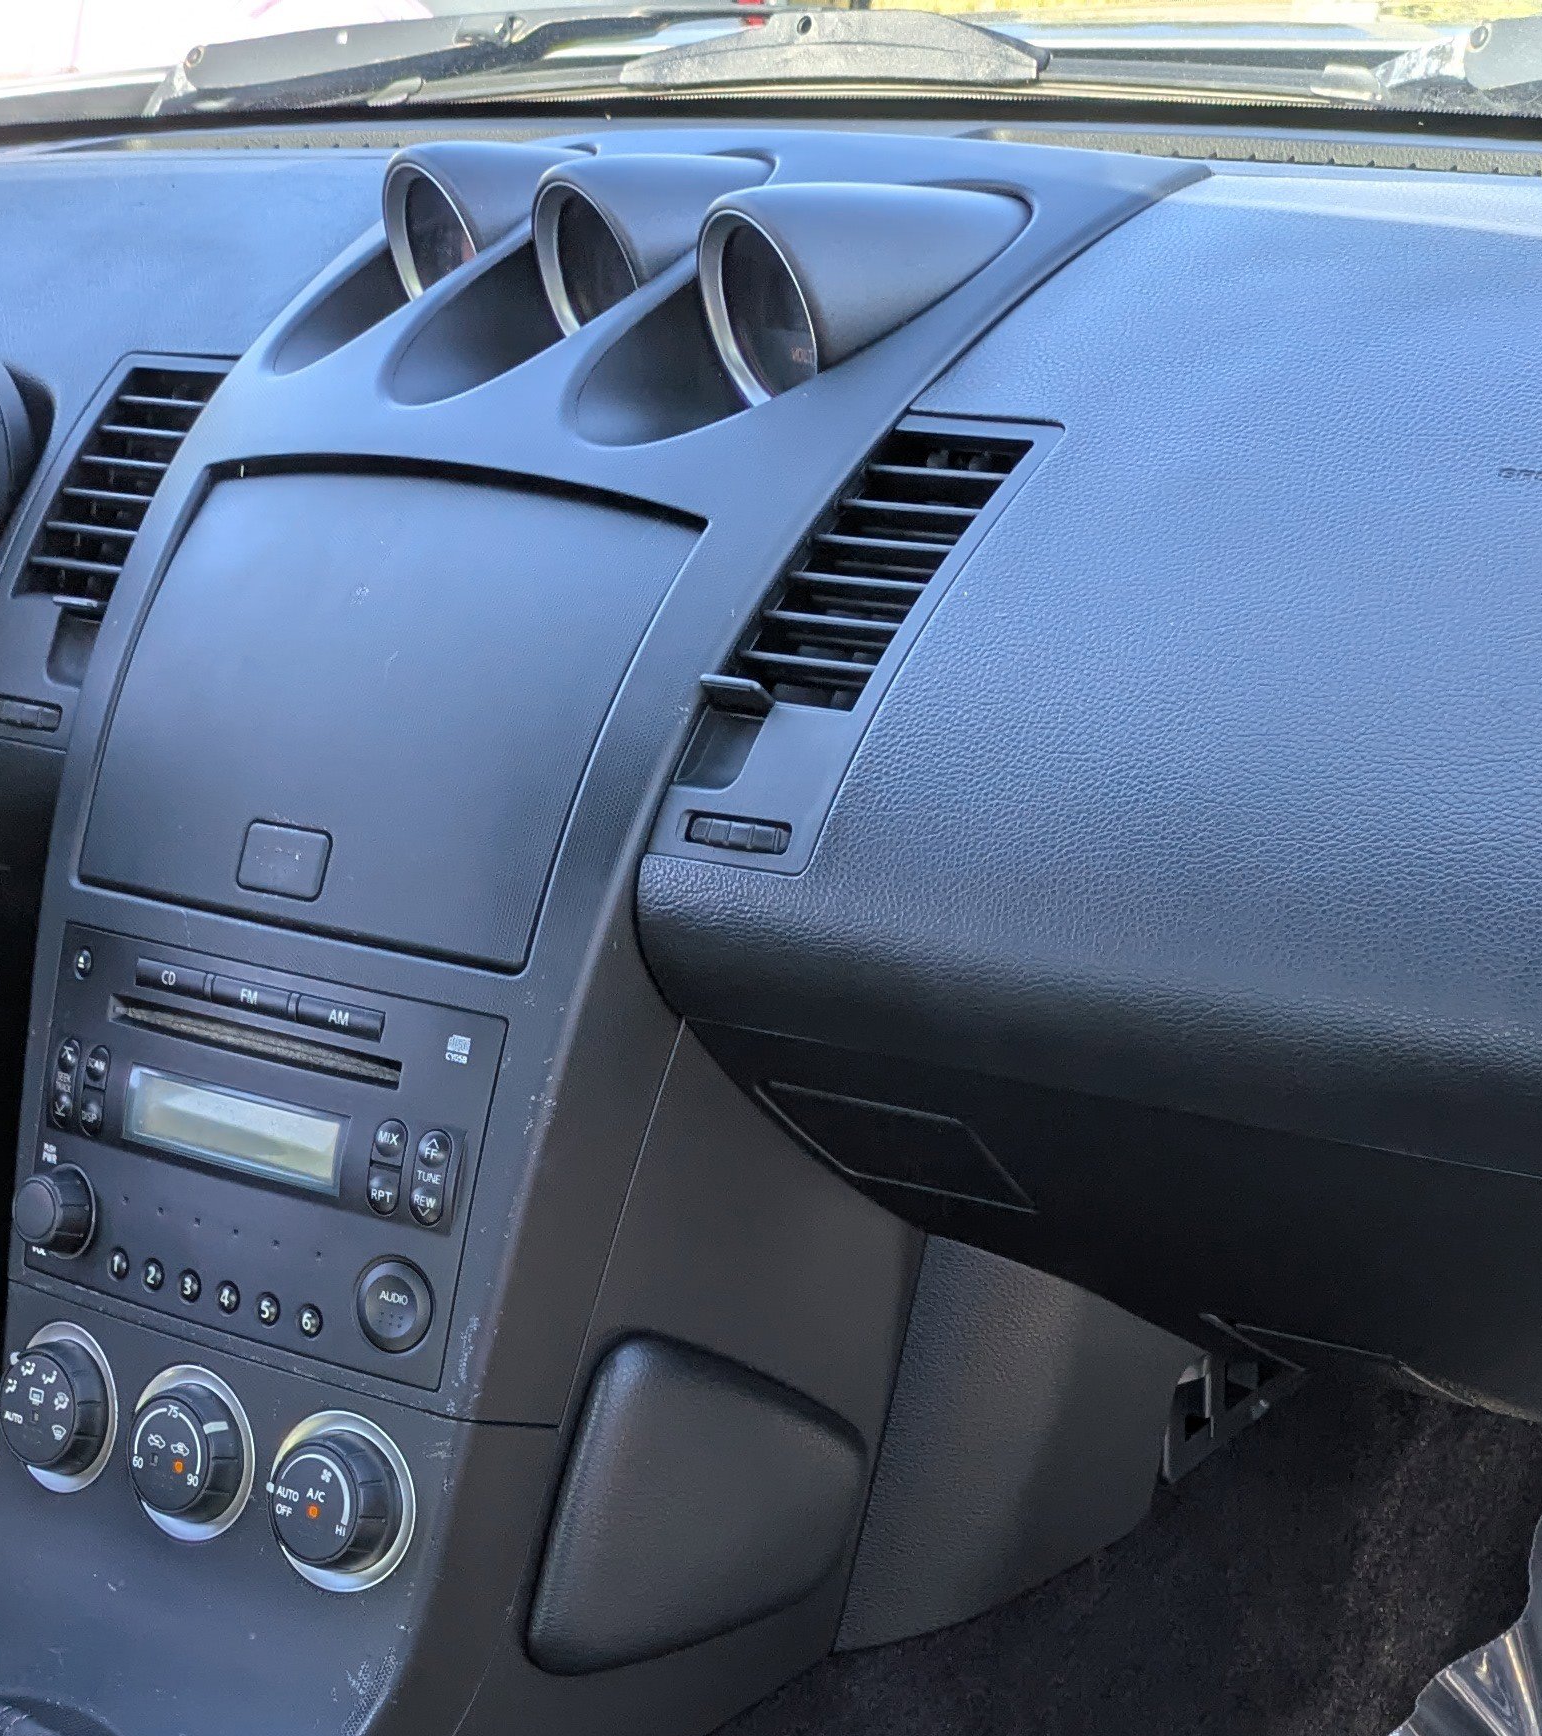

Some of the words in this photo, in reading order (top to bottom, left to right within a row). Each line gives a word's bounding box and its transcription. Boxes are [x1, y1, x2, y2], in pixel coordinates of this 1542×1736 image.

[161, 970, 177, 986] CD
[240, 988, 258, 1005] FM
[328, 1009, 350, 1026] AM
[376, 1131, 399, 1146] MIX
[424, 1148, 438, 1160] FF
[416, 1169, 442, 1185] TUNE
[370, 1189, 393, 1203] RPT
[413, 1194, 436, 1209] REW
[113, 1255, 120, 1273] 1
[146, 1265, 156, 1284] 2
[183, 1277, 192, 1295] 3
[219, 1289, 230, 1307] 4
[260, 1301, 271, 1319] 5
[301, 1312, 312, 1330] 6
[379, 1290, 409, 1306] AUDIO
[4, 1411, 23, 1425] AUTO
[166, 1404, 181, 1419] 75
[132, 1456, 144, 1470] 60
[186, 1473, 200, 1487] 90
[275, 1486, 299, 1502] AUTO
[306, 1488, 326, 1503] A/C
[275, 1503, 293, 1517] OFF
